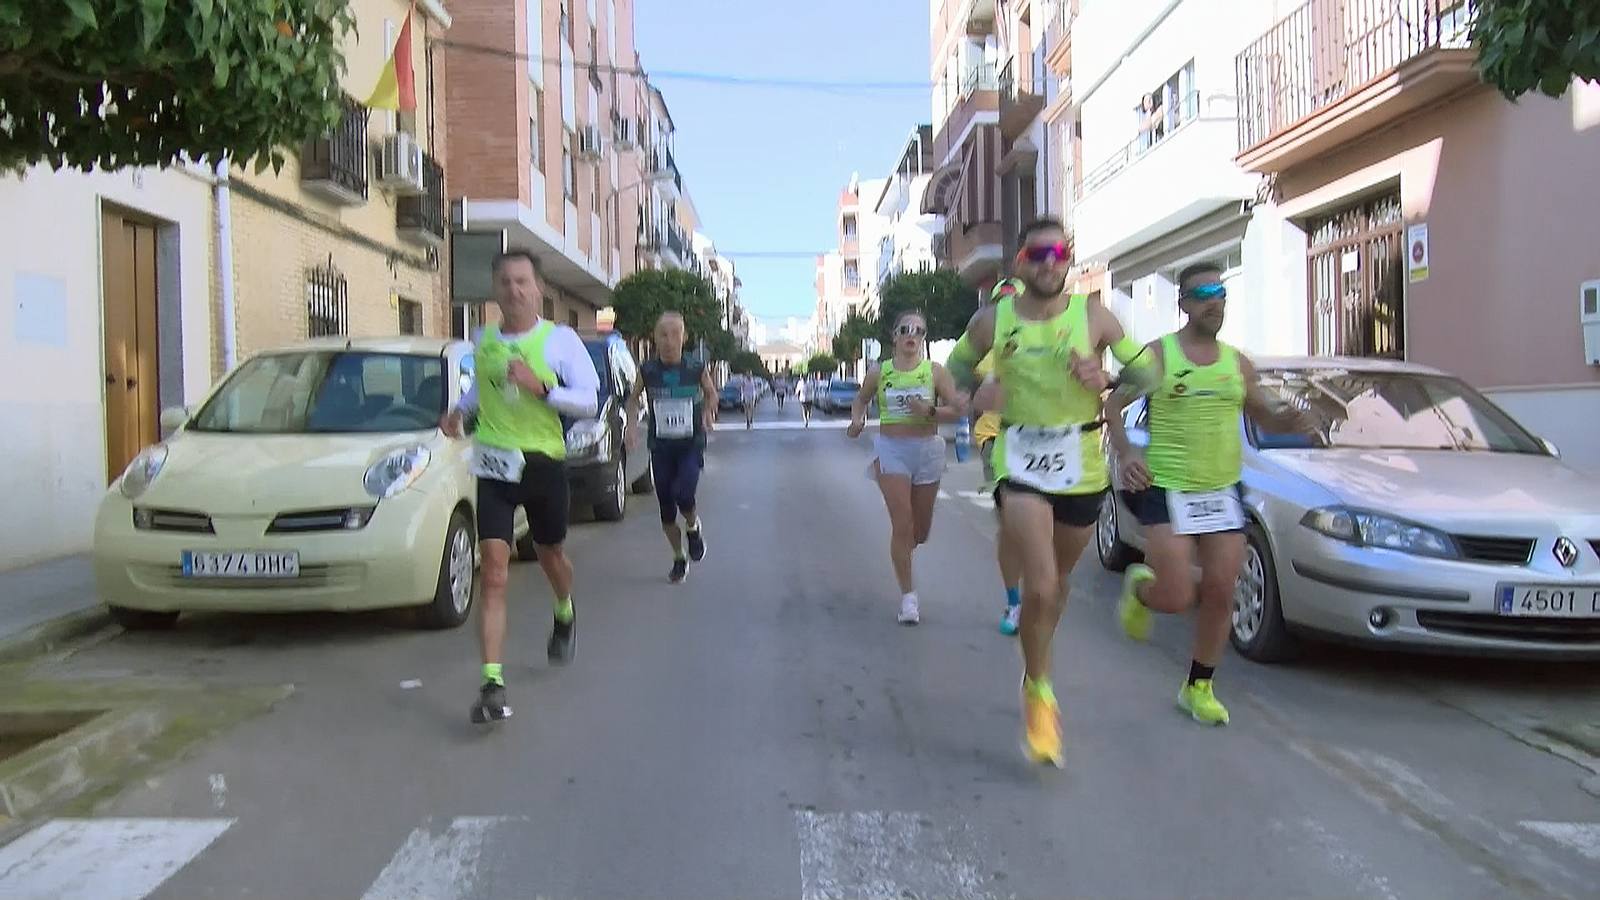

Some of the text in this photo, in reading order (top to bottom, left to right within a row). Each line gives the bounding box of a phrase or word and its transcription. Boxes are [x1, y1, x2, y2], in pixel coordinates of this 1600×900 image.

[1024, 452, 1066, 473] 245
[194, 552, 294, 574] 6374 DHC
[1520, 590, 1575, 613] 4501
